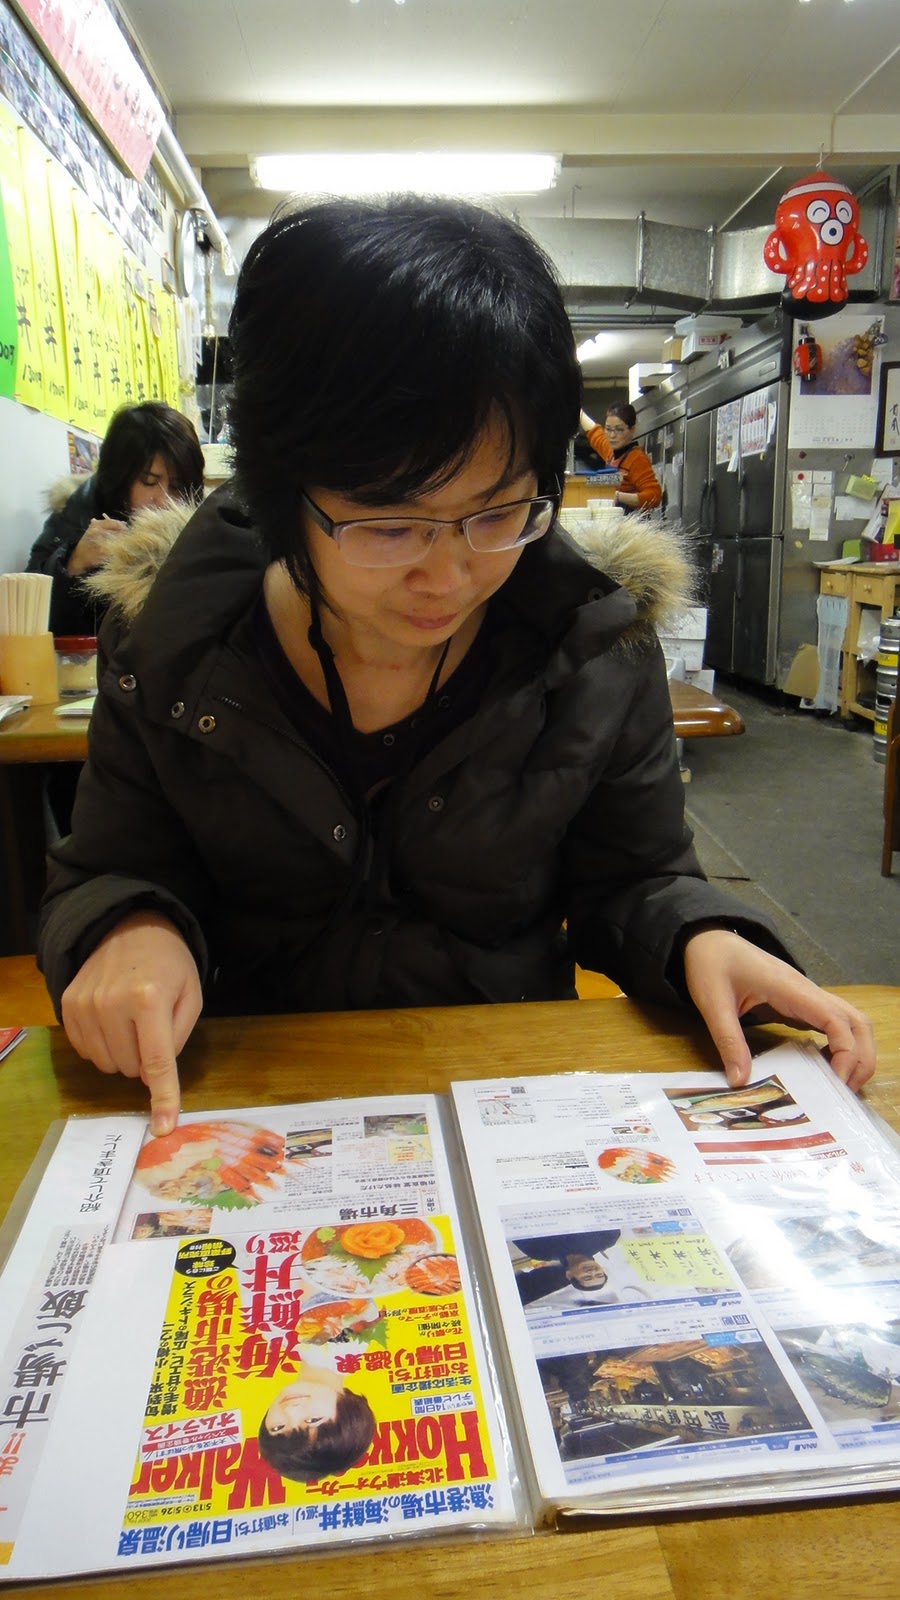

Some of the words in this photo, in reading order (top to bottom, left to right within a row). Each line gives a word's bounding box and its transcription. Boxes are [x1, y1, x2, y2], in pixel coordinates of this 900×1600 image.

[79, 1134, 122, 1213] 紹介して頂きました
[338, 1202, 419, 1220] 三角市場
[231, 1230, 304, 1380] 海鮮丼巡り
[0, 1289, 89, 1429] 市場ご飯
[161, 1280, 197, 1415] 増毛の甘エビ、広尾のトキシラズ
[182, 1274, 238, 1412] 漁港市場の
[335, 1342, 467, 1374] 日帰り温泉
[387, 1361, 469, 1383] お値打ち!
[392, 1375, 472, 1394] 生活応援企画
[413, 1392, 472, 1406] テレビ番組表
[144, 1412, 236, 1441] オムライス
[128, 1437, 286, 1510] Walker
[305, 1467, 444, 1496] 北海道ウォーカー
[295, 1483, 494, 1531] 漁港市場の海鮮丼巡り
